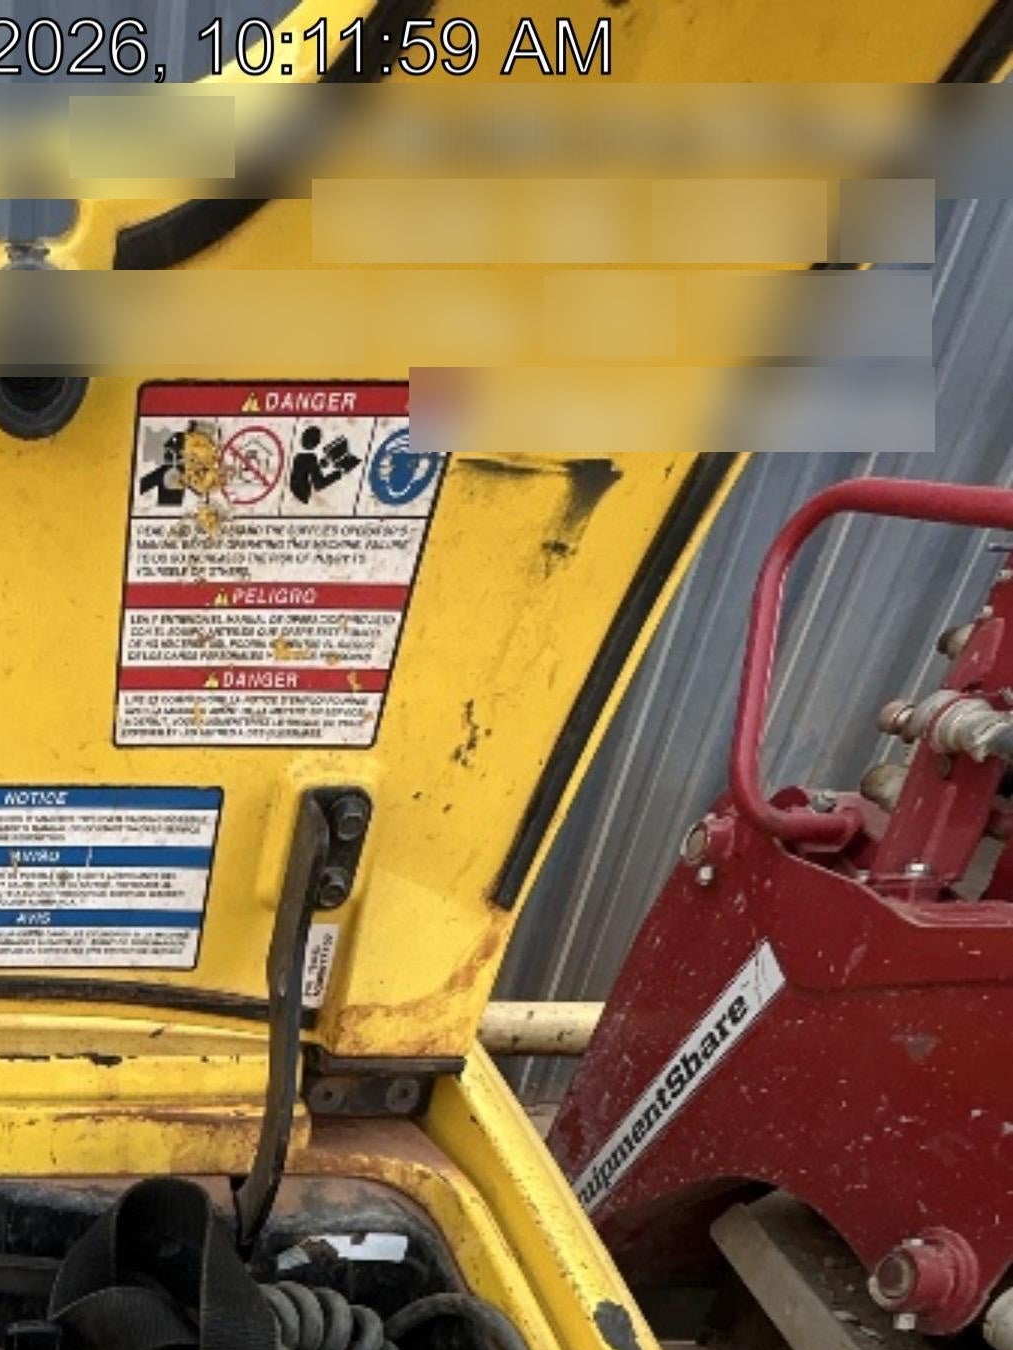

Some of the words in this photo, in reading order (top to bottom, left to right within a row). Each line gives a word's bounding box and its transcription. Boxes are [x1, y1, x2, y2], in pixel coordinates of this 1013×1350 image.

[264, 391, 358, 413] DANGER
[231, 587, 319, 605] PELIGRO
[221, 672, 299, 688] DANGER
[3, 790, 69, 806] NOTICE
[578, 993, 750, 1205] uipmentShare
